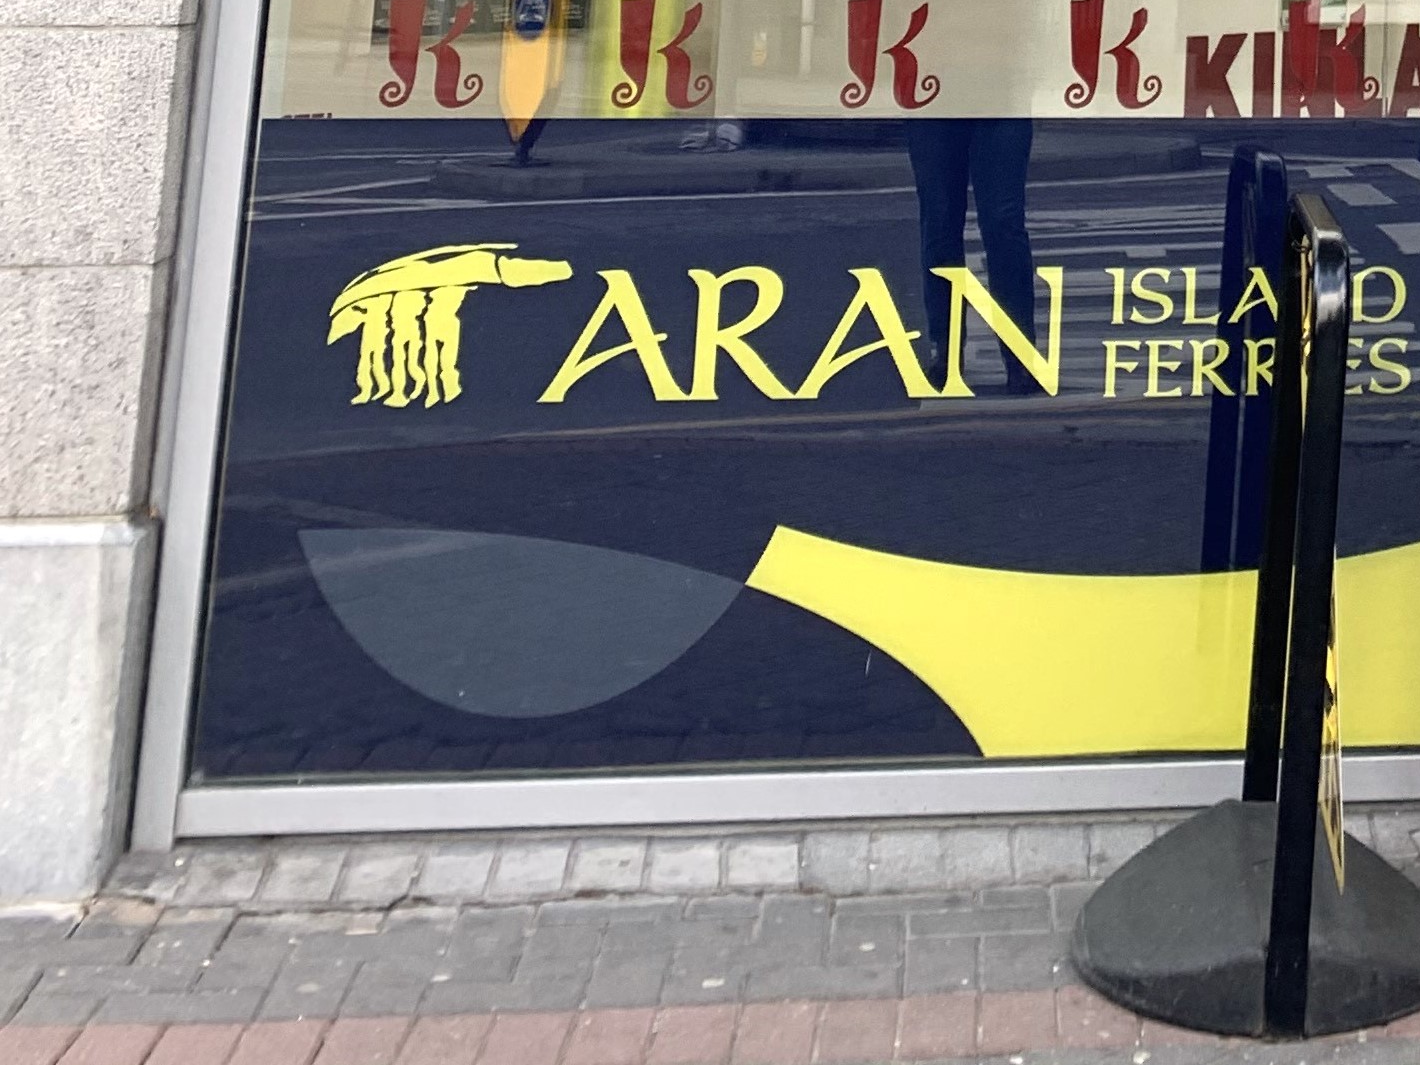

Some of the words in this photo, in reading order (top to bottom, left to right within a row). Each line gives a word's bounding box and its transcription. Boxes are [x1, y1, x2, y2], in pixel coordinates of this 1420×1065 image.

[537, 266, 1063, 403] ARAN
[1105, 266, 1407, 325] ISLAD
[1102, 337, 1412, 398] FERRES
